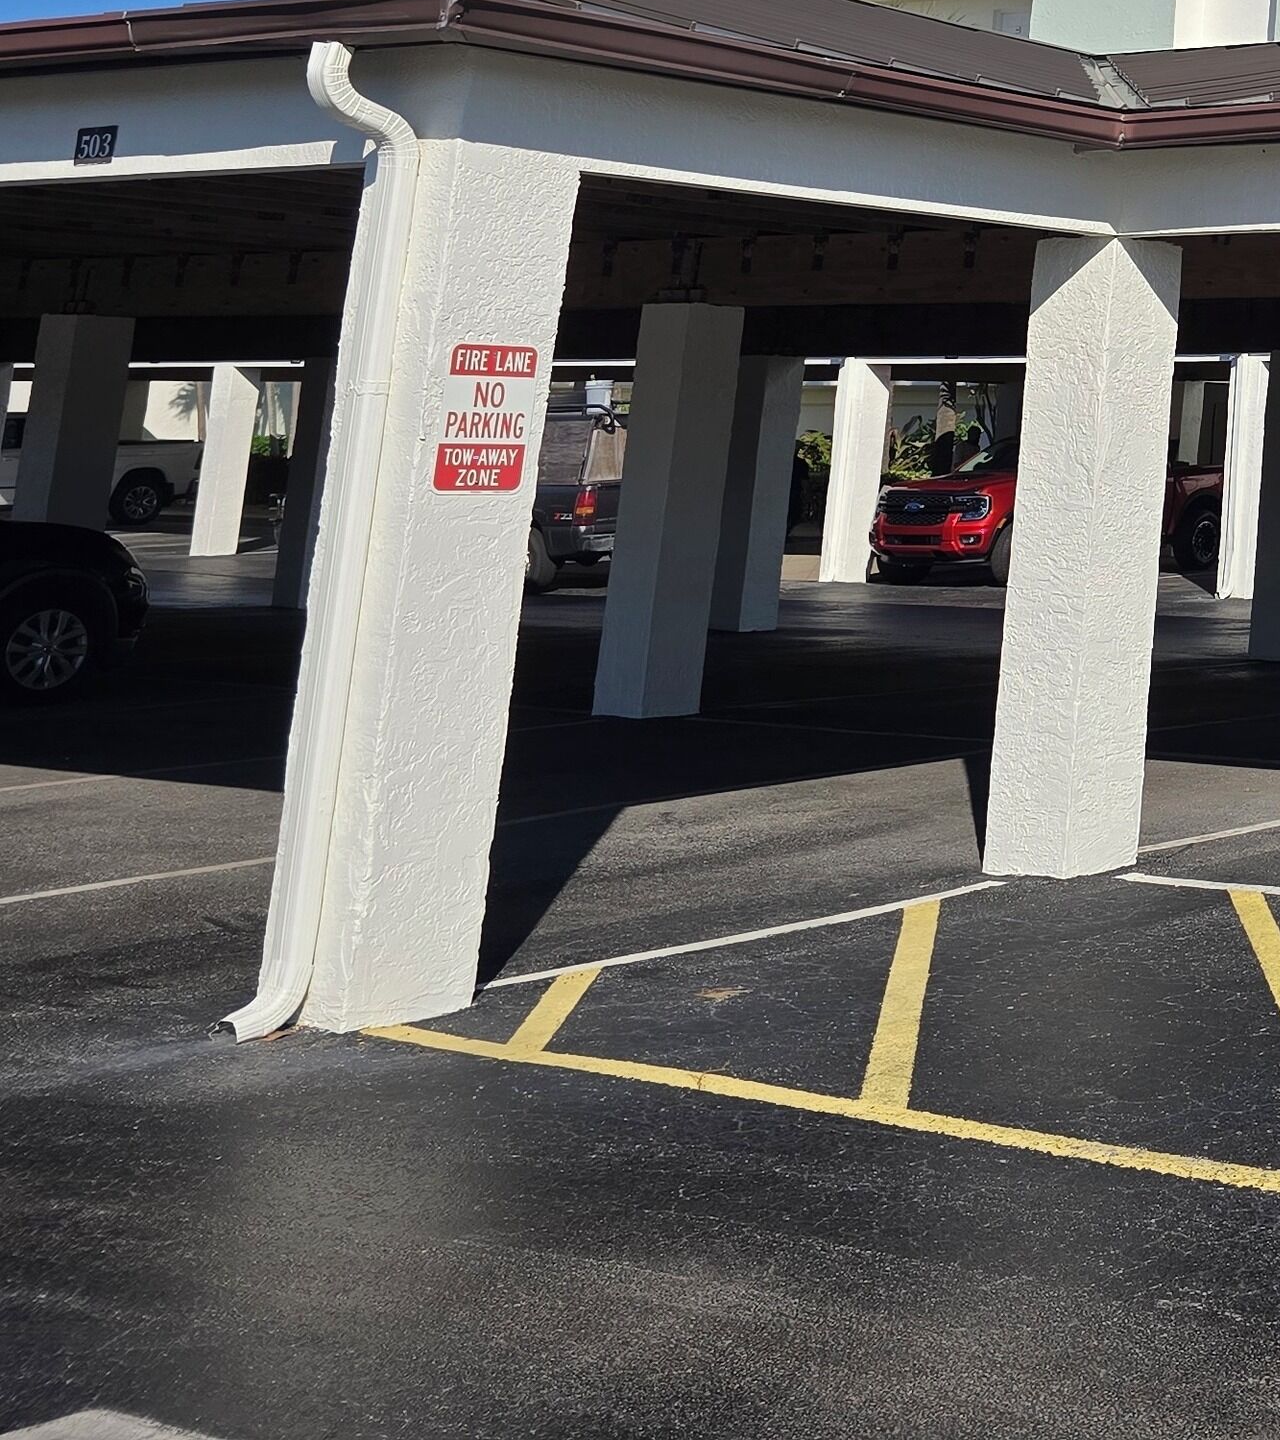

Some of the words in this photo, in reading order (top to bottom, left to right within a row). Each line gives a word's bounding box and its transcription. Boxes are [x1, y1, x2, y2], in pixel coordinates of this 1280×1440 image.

[78, 133, 112, 159] 503
[455, 349, 490, 371] FIRE
[495, 351, 534, 373] LANE
[474, 381, 505, 408] NO
[445, 411, 525, 439] PARKING
[444, 448, 519, 466] TOW-AWAY
[455, 469, 501, 487] ZONE
